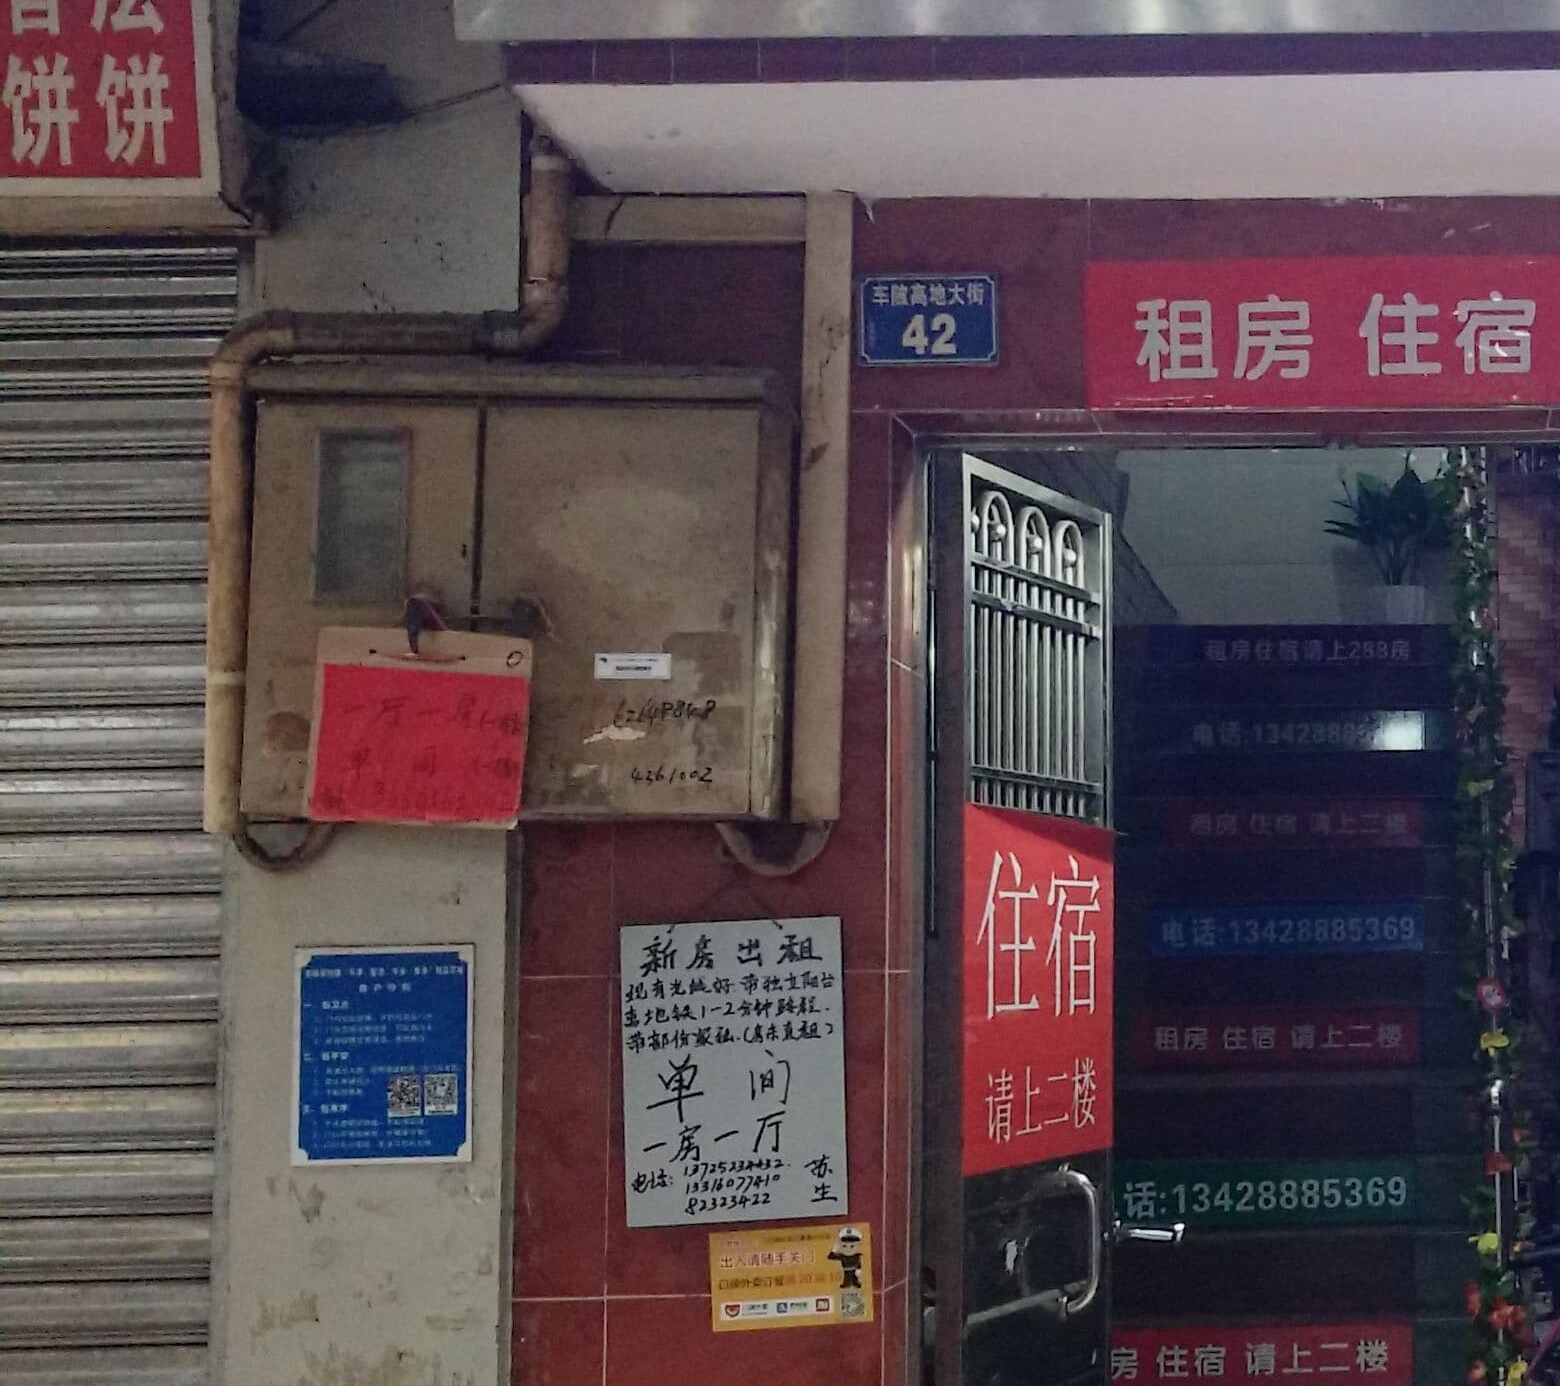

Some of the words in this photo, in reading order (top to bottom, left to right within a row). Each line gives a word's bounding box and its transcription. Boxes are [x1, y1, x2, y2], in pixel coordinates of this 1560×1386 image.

[872, 282, 984, 306] 车陂高地大街
[902, 314, 957, 354] 42
[1133, 297, 1311, 382] 租房
[1359, 292, 1535, 376] 住宿
[977, 850, 1100, 1019] 住宿
[1161, 916, 1416, 947] 电话:13428885369
[641, 934, 823, 978] 新房出租
[1154, 1026, 1207, 1051] 租房
[1222, 1025, 1277, 1051] 住宿
[1291, 1024, 1401, 1050] 请上二楼
[646, 1049, 791, 1123] 单间
[986, 1057, 1096, 1143] 请上二楼
[643, 1111, 786, 1163] 一房一厅
[1113, 1175, 1407, 1219] 话:13428885369
[1157, 1345, 1226, 1379] 住宿
[1246, 1340, 1389, 1375] 请上二楼
